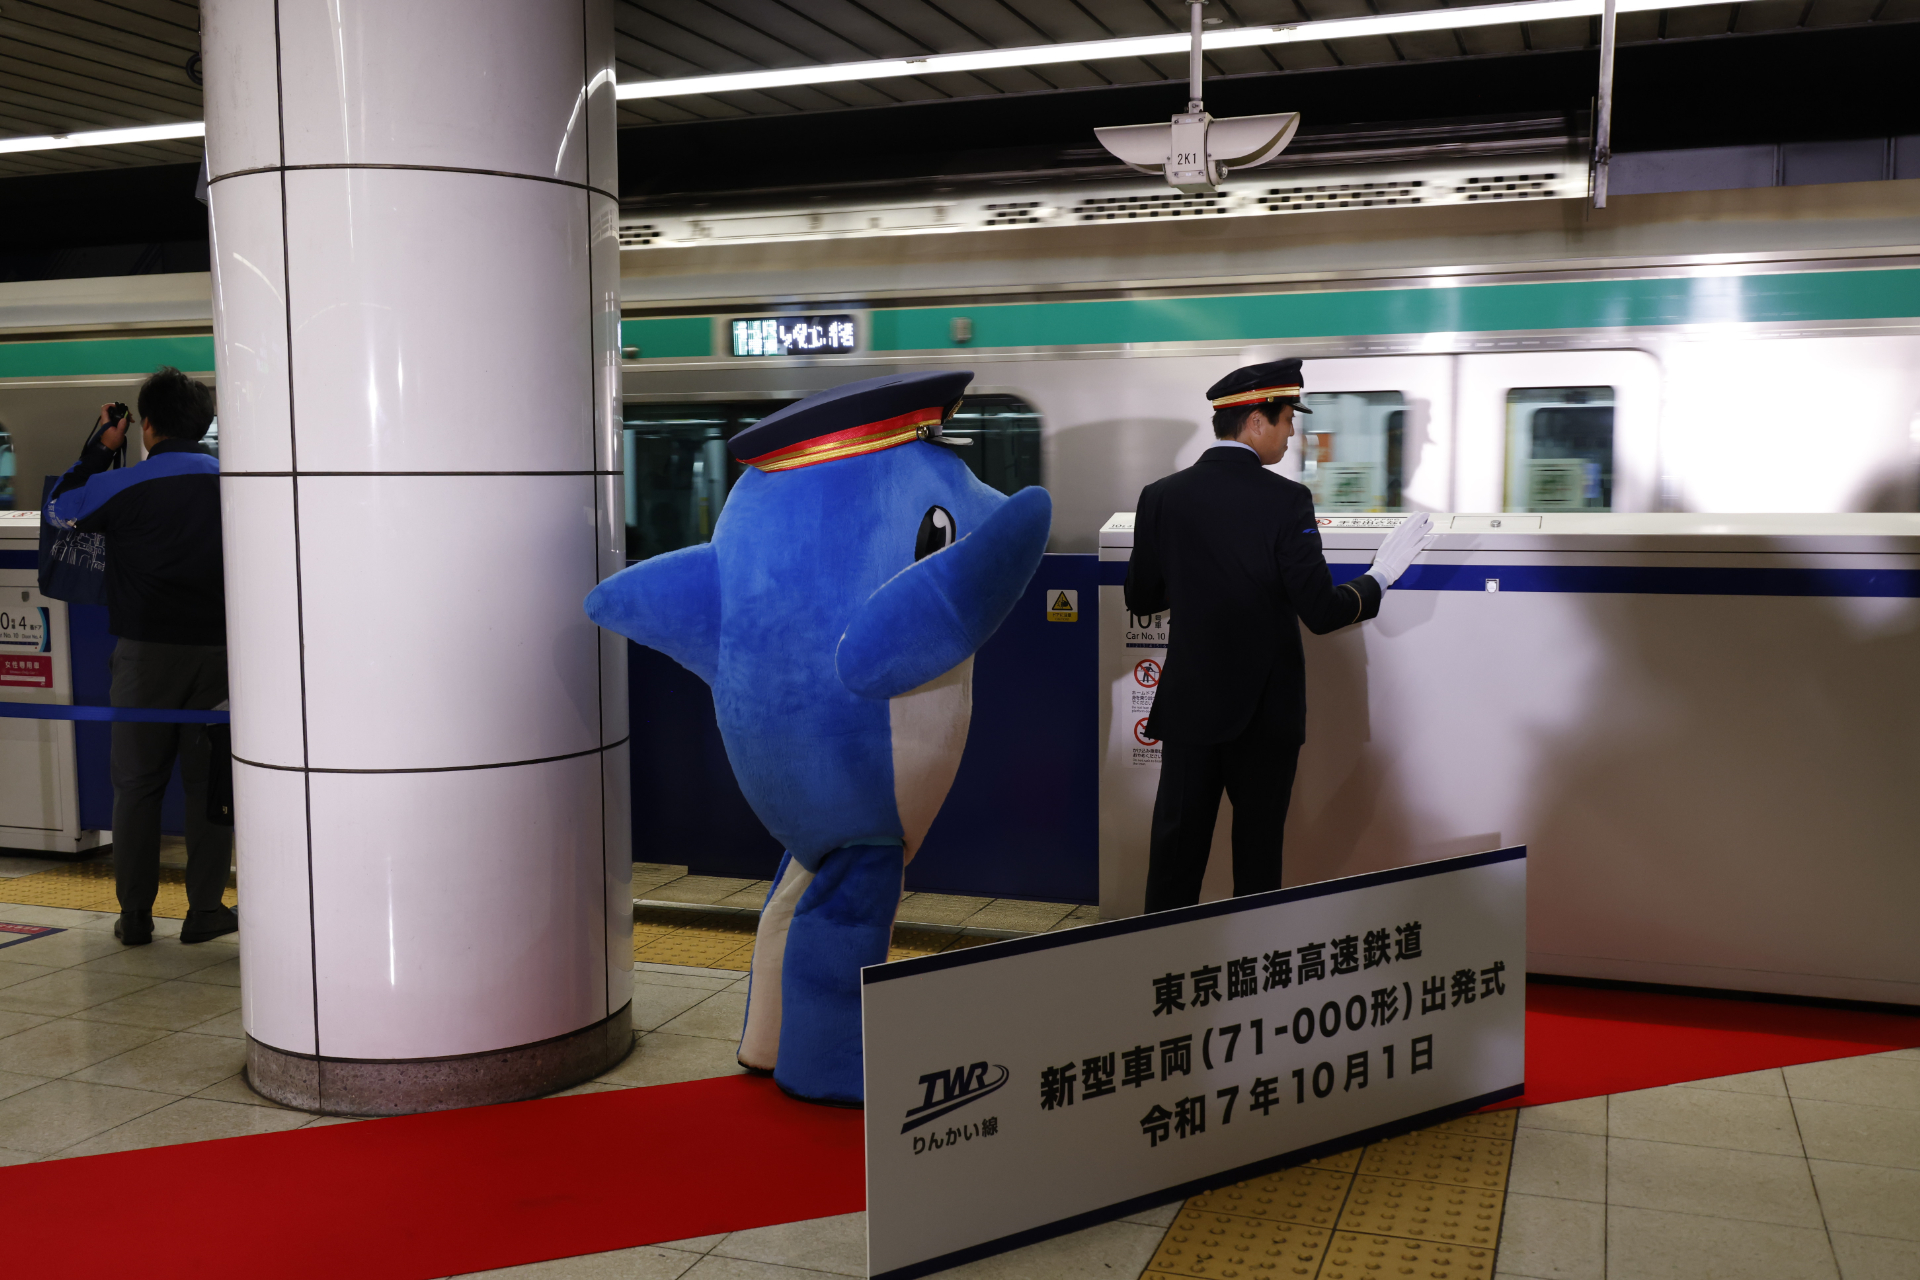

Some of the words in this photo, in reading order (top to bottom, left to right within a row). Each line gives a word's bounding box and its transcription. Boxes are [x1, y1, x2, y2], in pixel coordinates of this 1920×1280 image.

[1177, 153, 1197, 165] 2K1
[19, 616, 27, 630] 4
[1126, 632, 1139, 640] Car
[1142, 632, 1154, 640] No.
[1152, 921, 1422, 1017] 東京臨海高速鉄道
[918, 1061, 988, 1107] TWR
[913, 1116, 998, 1155] りんかい線
